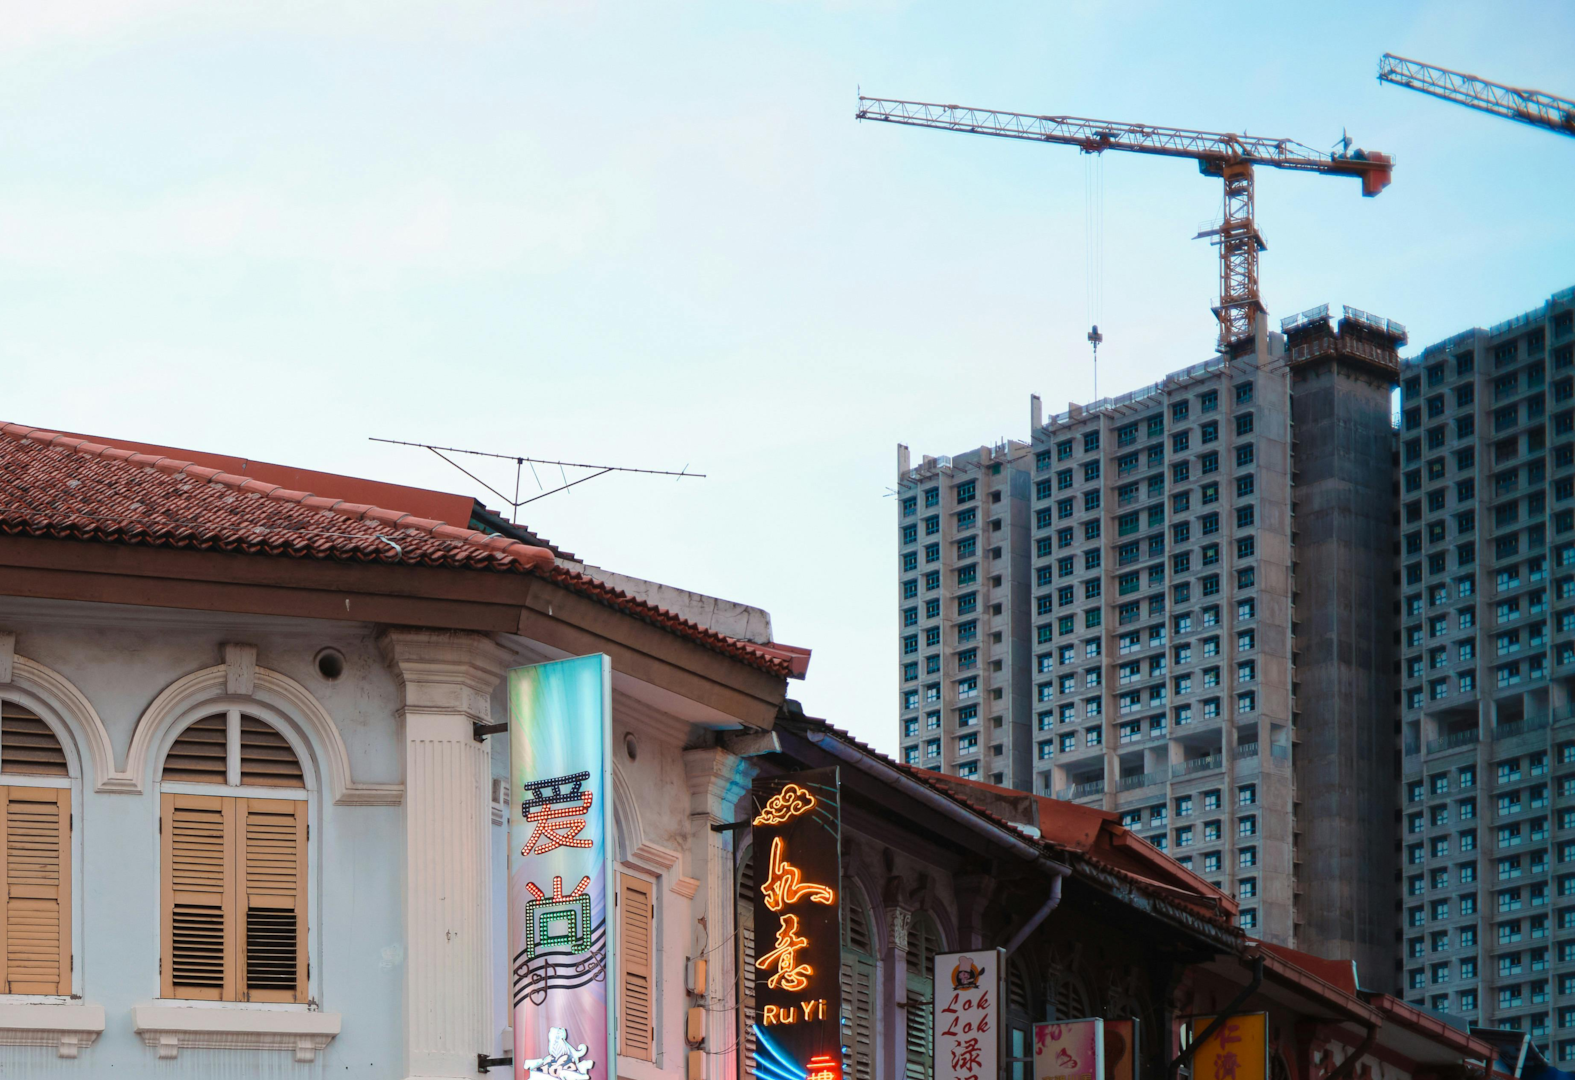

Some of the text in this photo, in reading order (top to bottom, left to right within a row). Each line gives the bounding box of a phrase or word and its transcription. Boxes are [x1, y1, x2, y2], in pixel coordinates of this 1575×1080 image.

[521, 771, 594, 959] 爱尚
[755, 836, 834, 991] 如意
[762, 998, 826, 1027] Ru Yi
[941, 989, 993, 1014] Lok
[941, 1013, 993, 1037] Lok
